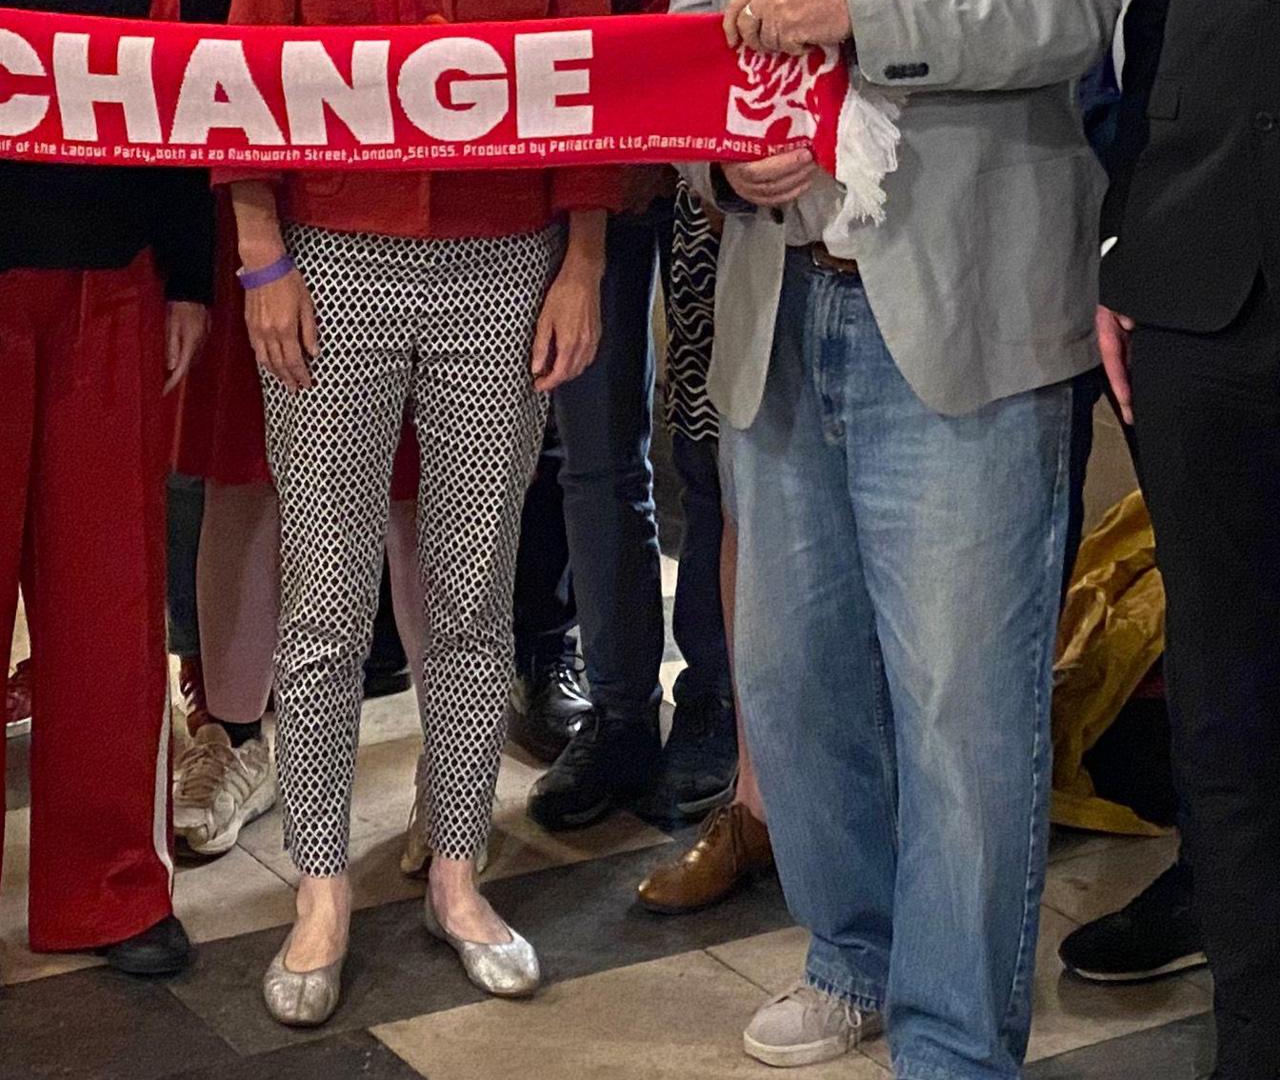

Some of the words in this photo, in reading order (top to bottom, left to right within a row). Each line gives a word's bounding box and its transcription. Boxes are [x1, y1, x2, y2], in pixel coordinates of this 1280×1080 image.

[16, 140, 30, 153] of
[34, 141, 57, 154] the
[61, 144, 107, 157] Labour
[190, 148, 203, 160] at
[207, 148, 225, 160] 20
[228, 147, 300, 161] Rushworth
[463, 140, 526, 157] Produced
[529, 140, 546, 157] by
